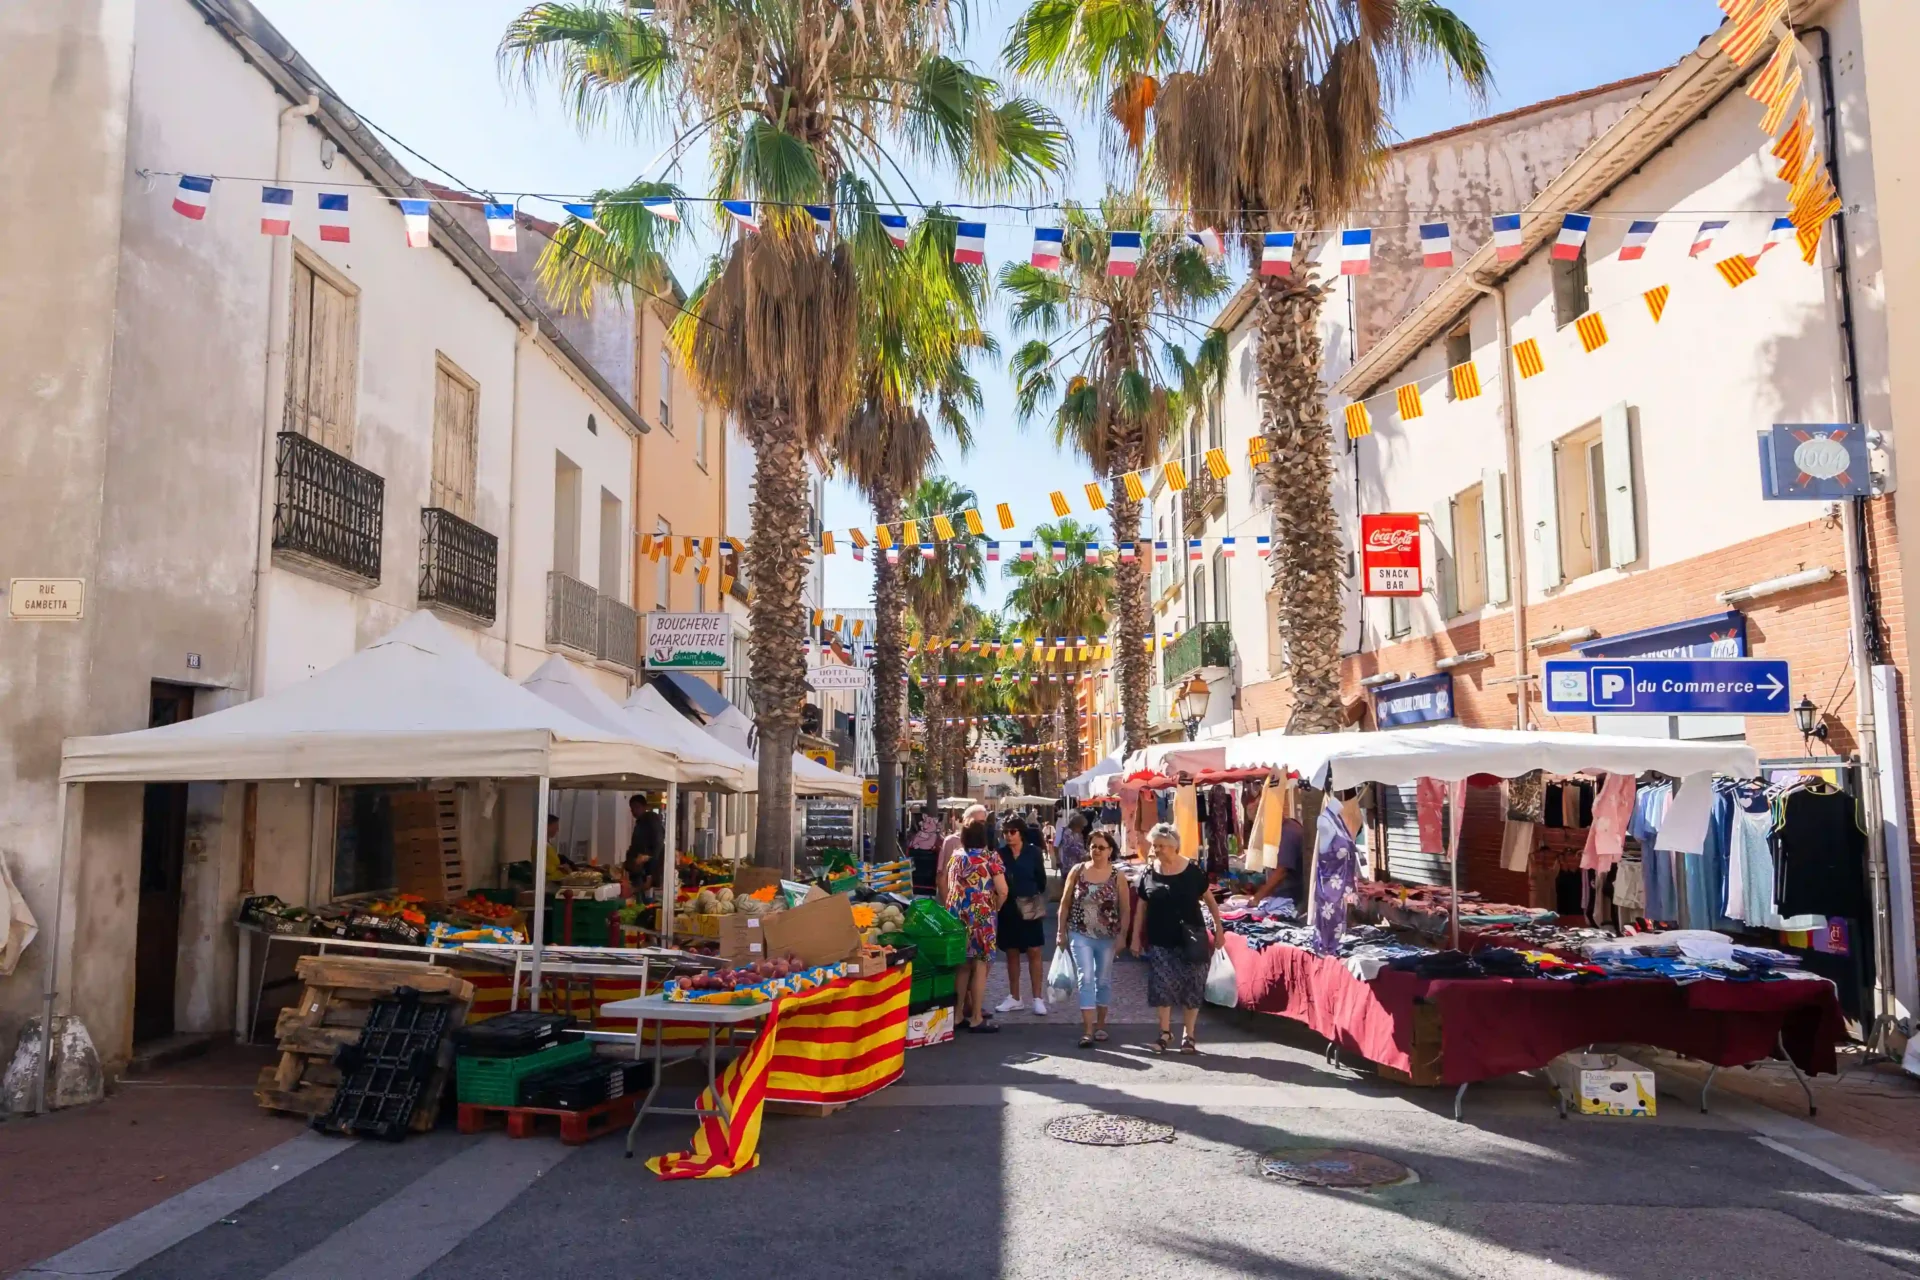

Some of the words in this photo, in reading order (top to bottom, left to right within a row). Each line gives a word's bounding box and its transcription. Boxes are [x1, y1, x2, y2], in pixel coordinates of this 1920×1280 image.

[1379, 569, 1409, 578] SNACK
[39, 584, 56, 594] RUE
[1386, 581, 1404, 590] BAR
[24, 599, 68, 609] GAMBETTA
[656, 617, 720, 630] BOUCHERIE
[649, 633, 726, 646] CHARCUTERIE
[821, 677, 864, 685] CENTRE
[1601, 674, 1625, 699] P
[1636, 679, 1657, 693] du
[1661, 679, 1754, 693] Commerce
